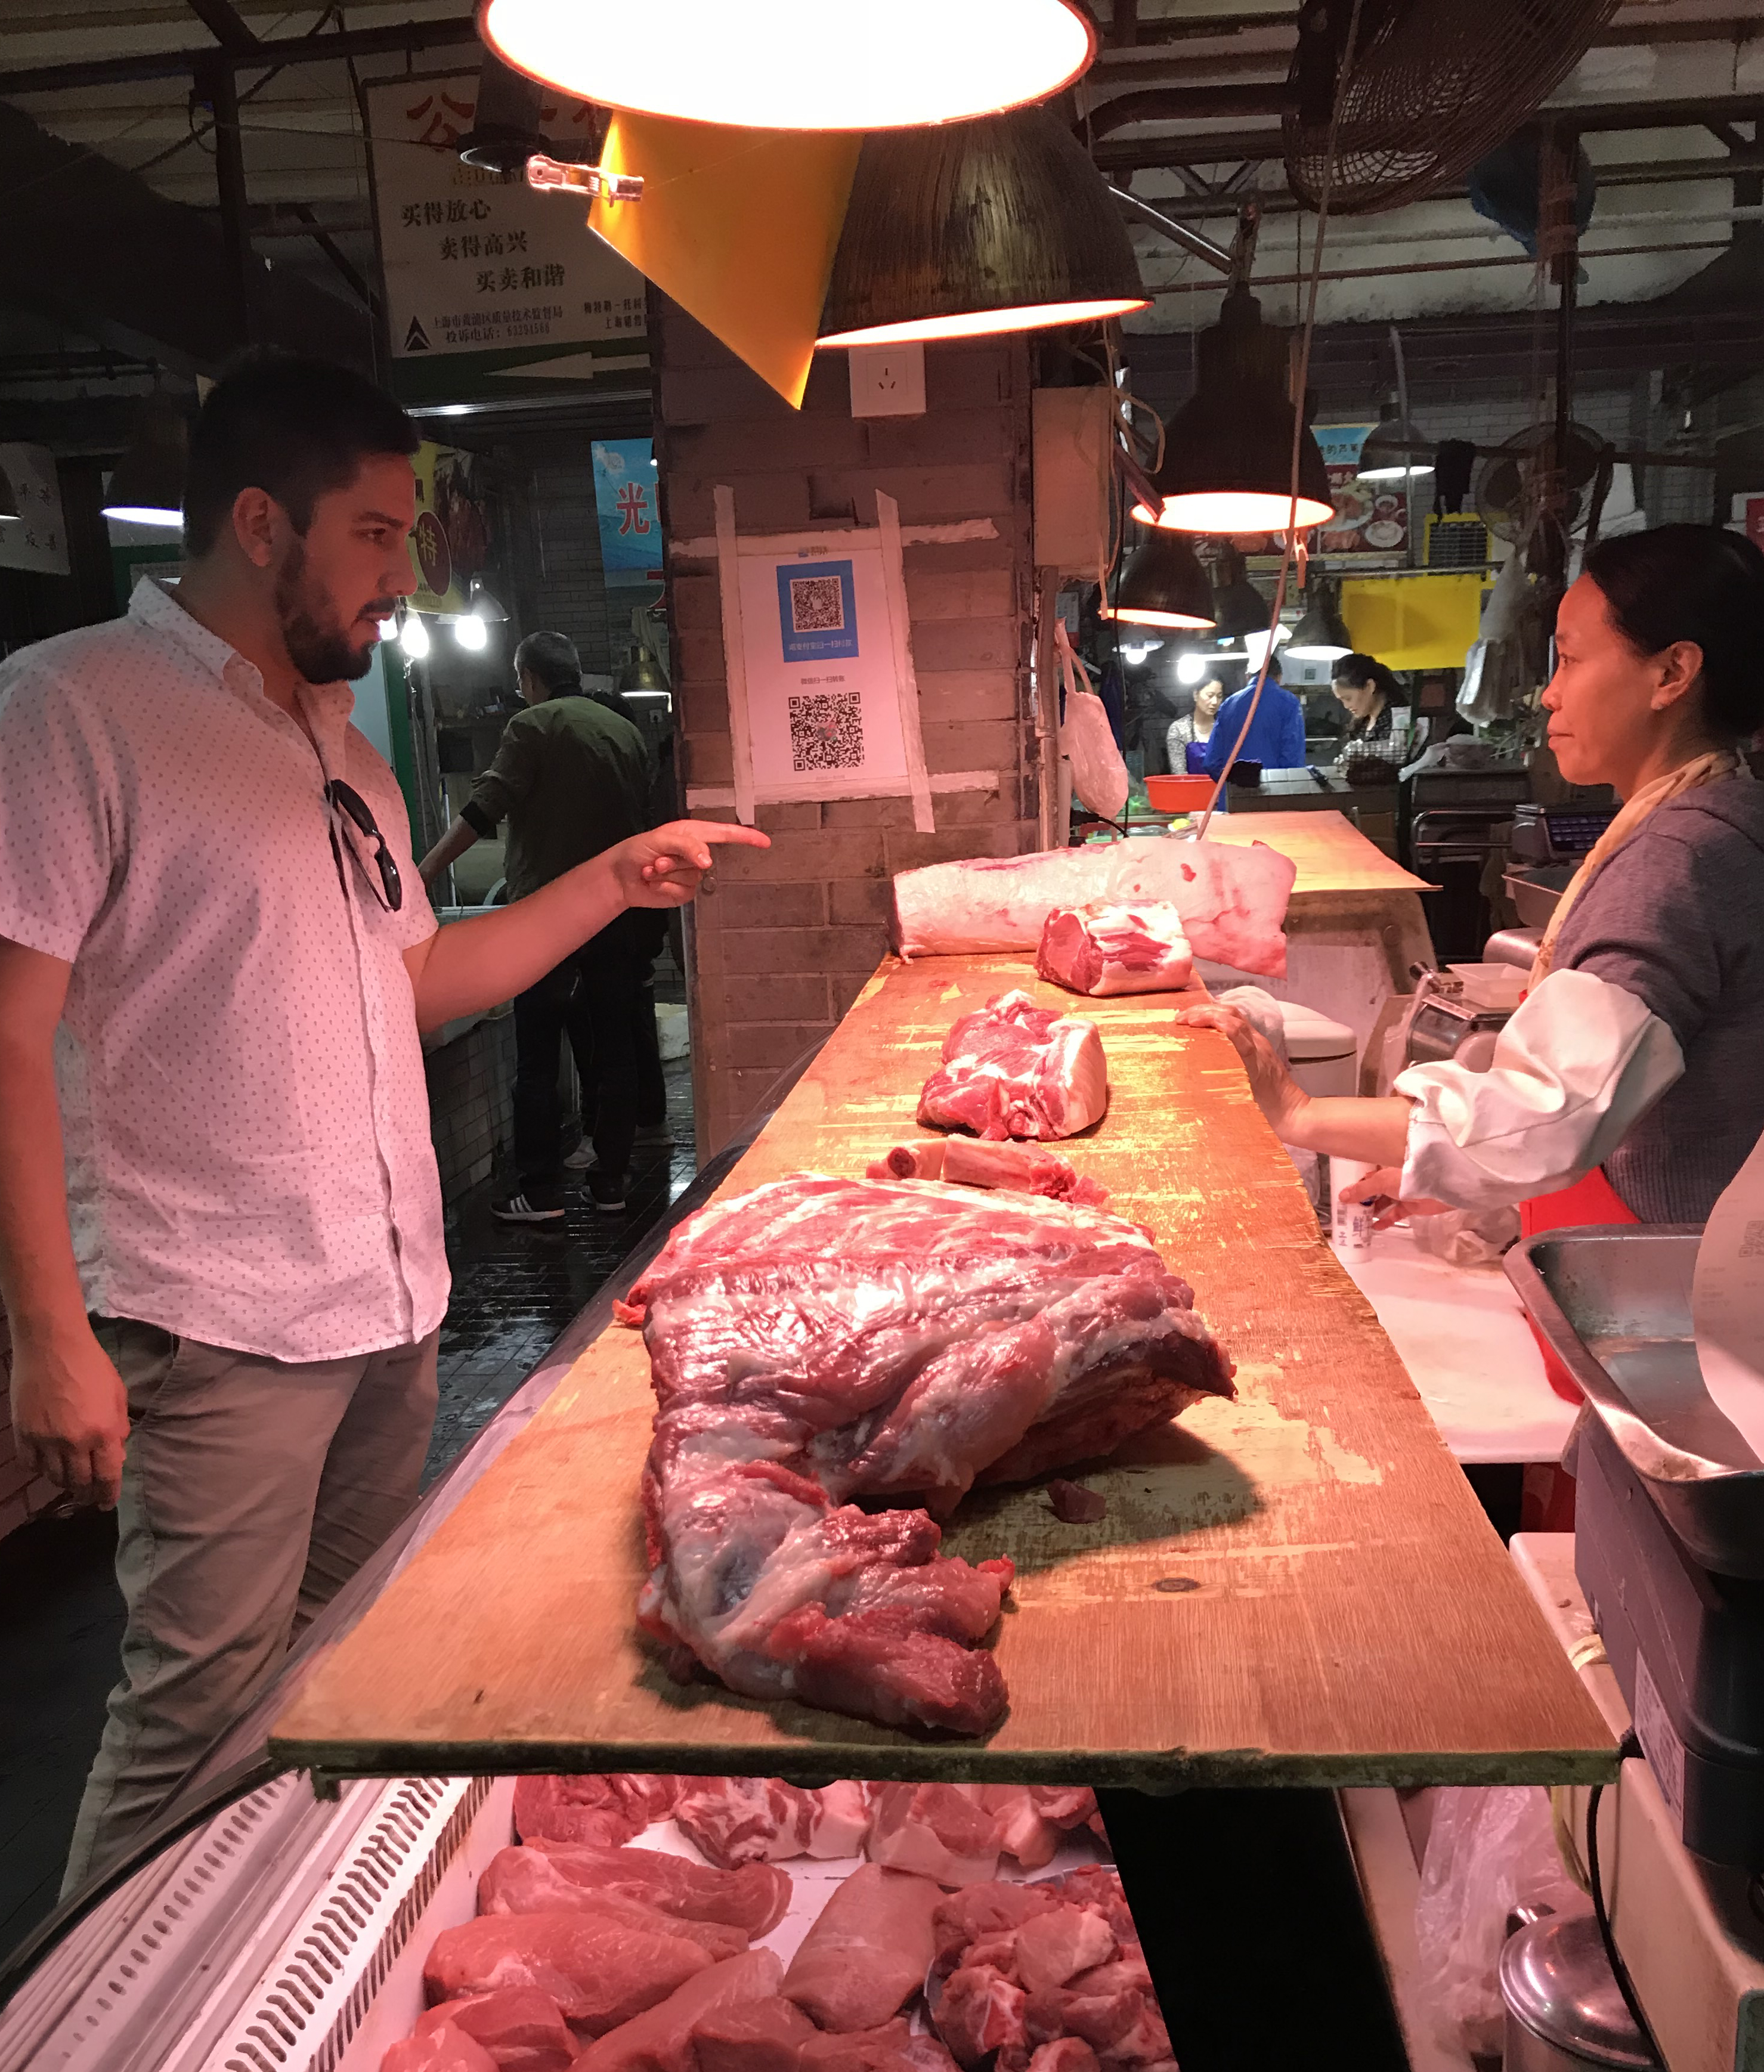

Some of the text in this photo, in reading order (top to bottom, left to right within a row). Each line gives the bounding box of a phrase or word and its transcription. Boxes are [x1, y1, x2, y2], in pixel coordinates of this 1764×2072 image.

[401, 199, 491, 227] 买得放心
[440, 229, 528, 260] 卖得高兴
[476, 263, 565, 293] 买卖和谐
[433, 305, 564, 329] 上海市黄浦区质量技术监督局
